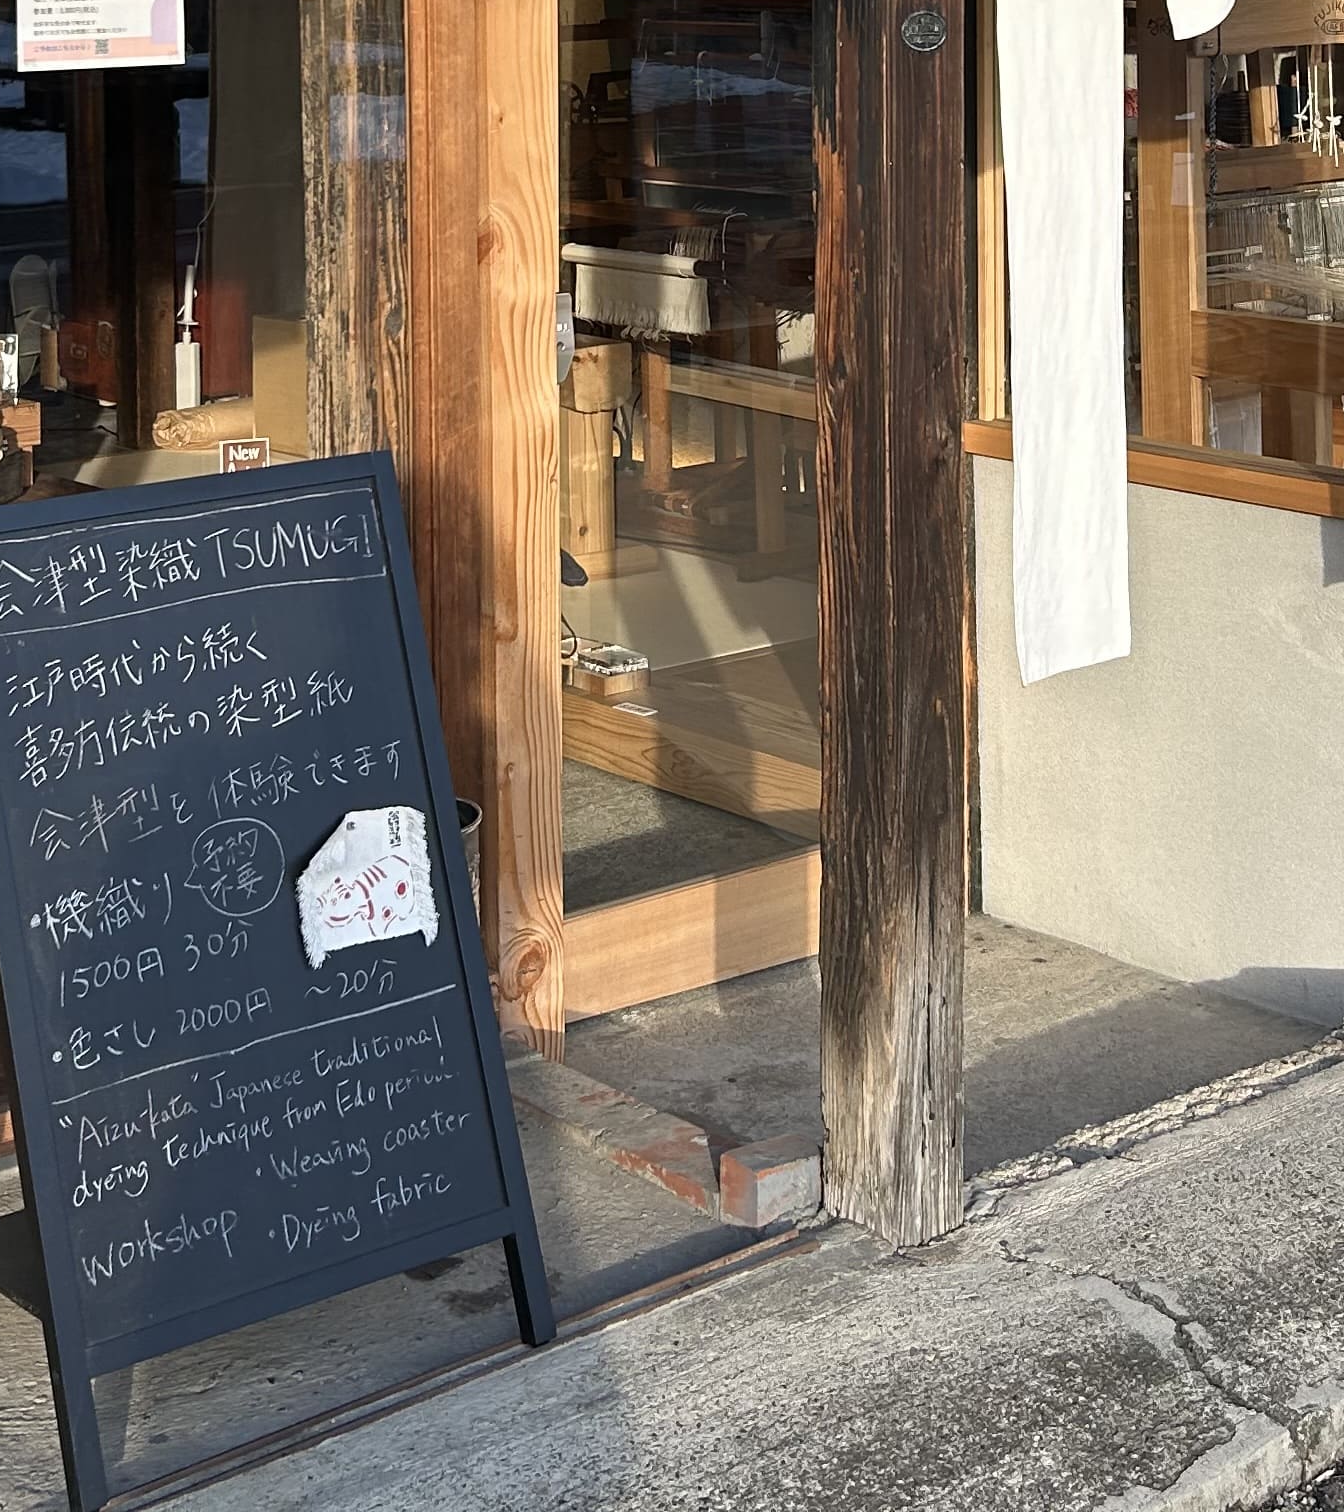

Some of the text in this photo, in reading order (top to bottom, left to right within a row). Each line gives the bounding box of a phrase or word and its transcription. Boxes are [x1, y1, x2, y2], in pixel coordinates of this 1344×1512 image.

[228, 444, 261, 461] New
[8, 622, 269, 717] 江戸時代から続く
[13, 670, 354, 789] 喜多方伝統の染型紙
[60, 921, 254, 1008] 1500円 30分
[176, 988, 273, 1036] 2000円
[209, 1068, 304, 1113] Japanese
[311, 1015, 443, 1076] traditional
[73, 1160, 149, 1207] dyeing
[162, 1112, 274, 1170] technique
[282, 1100, 328, 1131] from
[336, 1079, 376, 1118] Edo
[382, 1109, 472, 1153] coaster
[80, 1209, 239, 1288] Workshop
[370, 1172, 453, 1217] fabric
